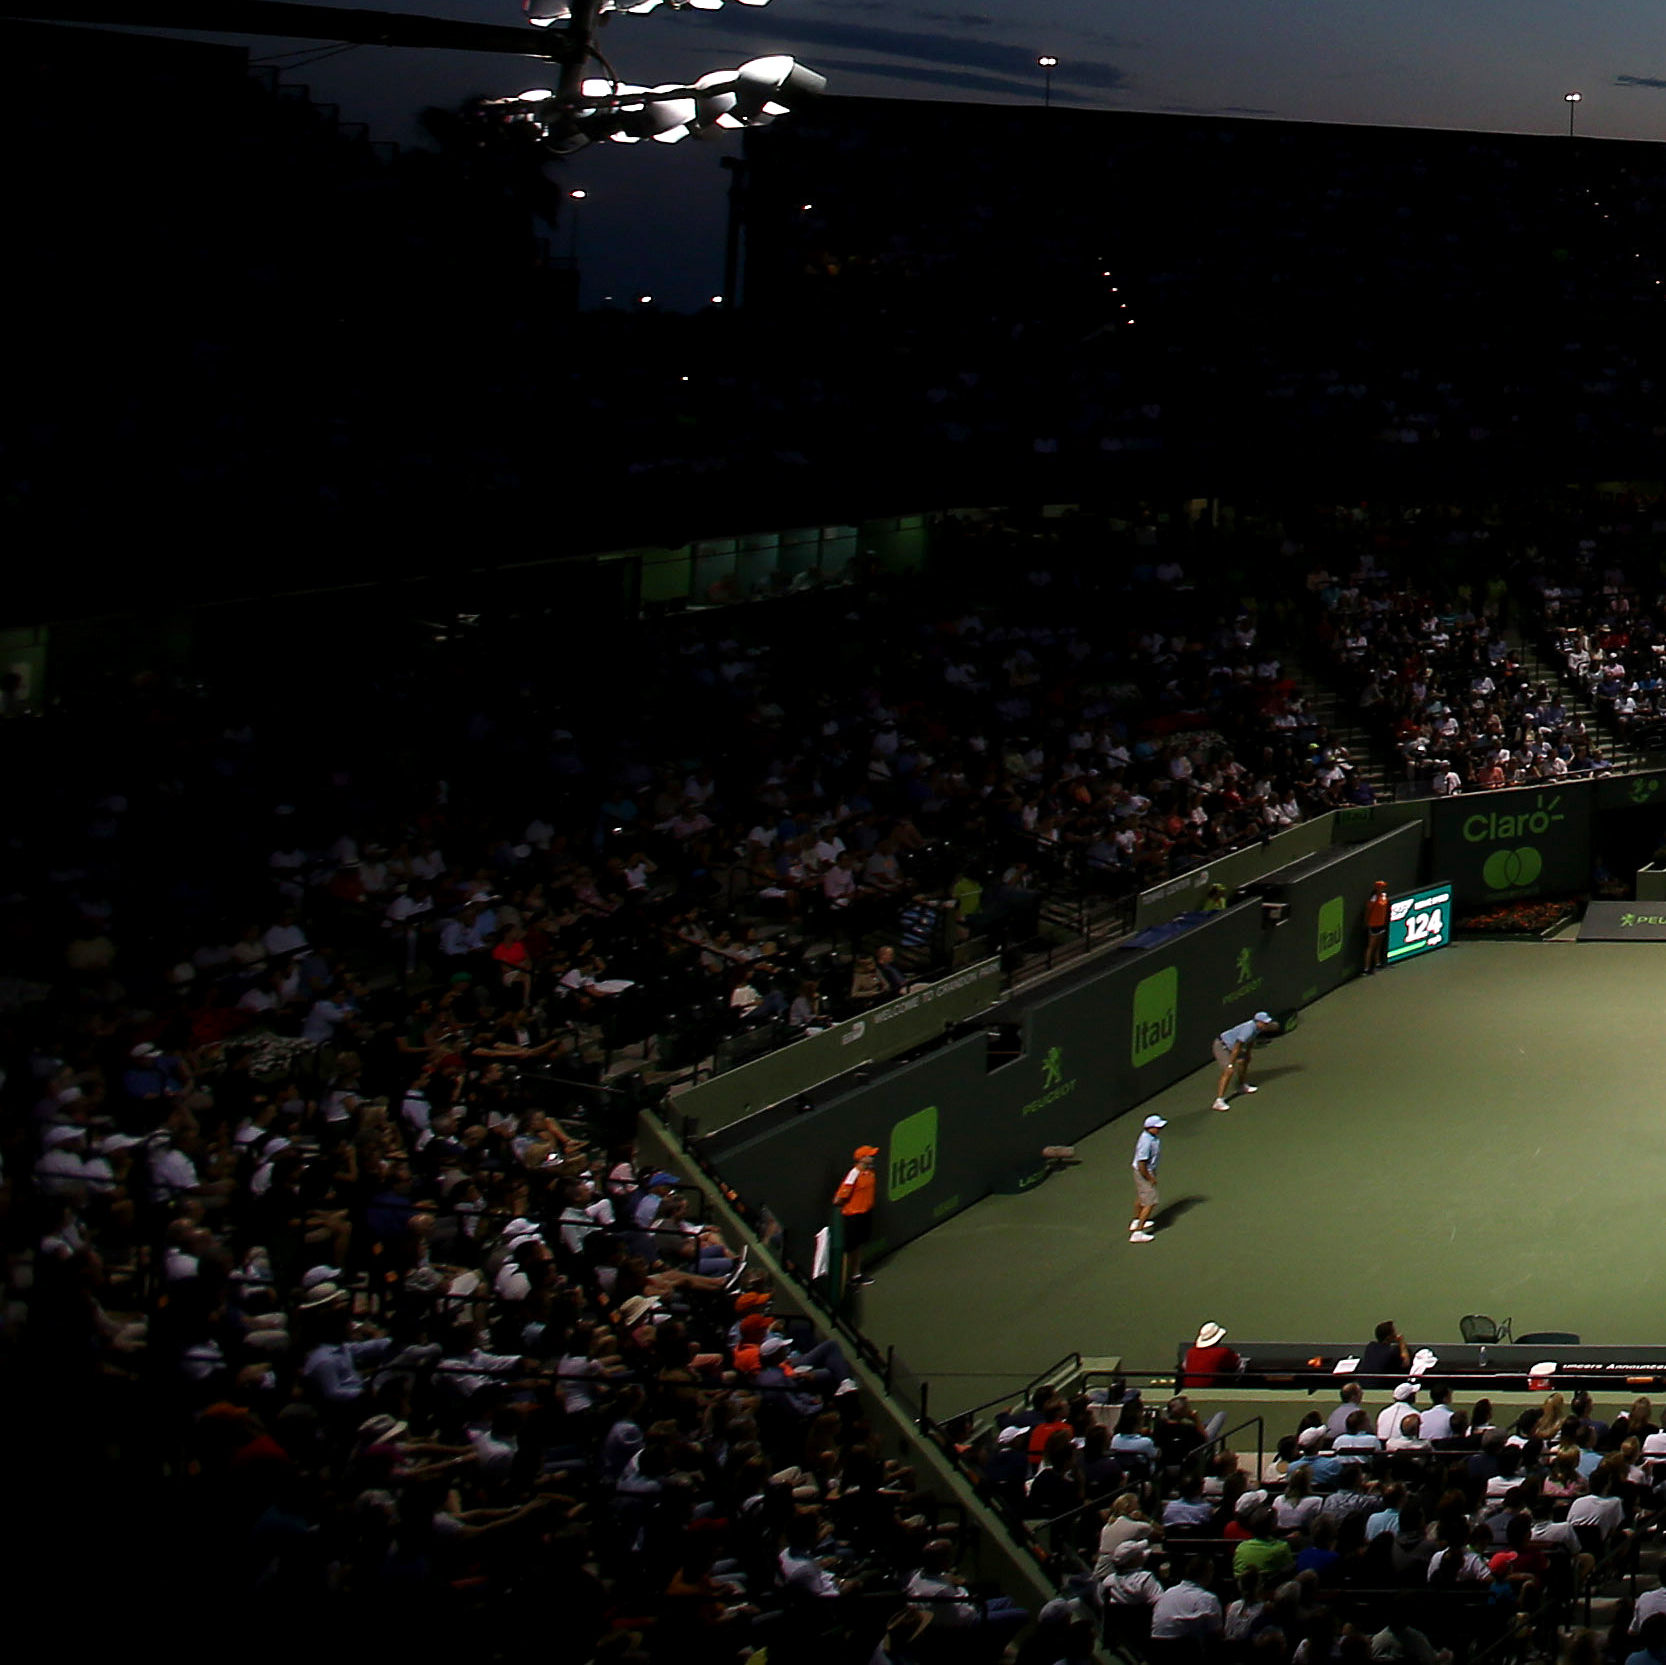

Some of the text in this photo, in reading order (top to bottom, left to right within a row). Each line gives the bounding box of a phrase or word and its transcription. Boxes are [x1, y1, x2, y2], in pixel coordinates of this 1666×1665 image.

[1463, 806, 1555, 842] Claro
[1321, 925, 1343, 951] Itaú
[1404, 909, 1443, 943] 124
[1135, 1007, 1174, 1055] Itaú
[890, 1144, 933, 1190] Itaú
